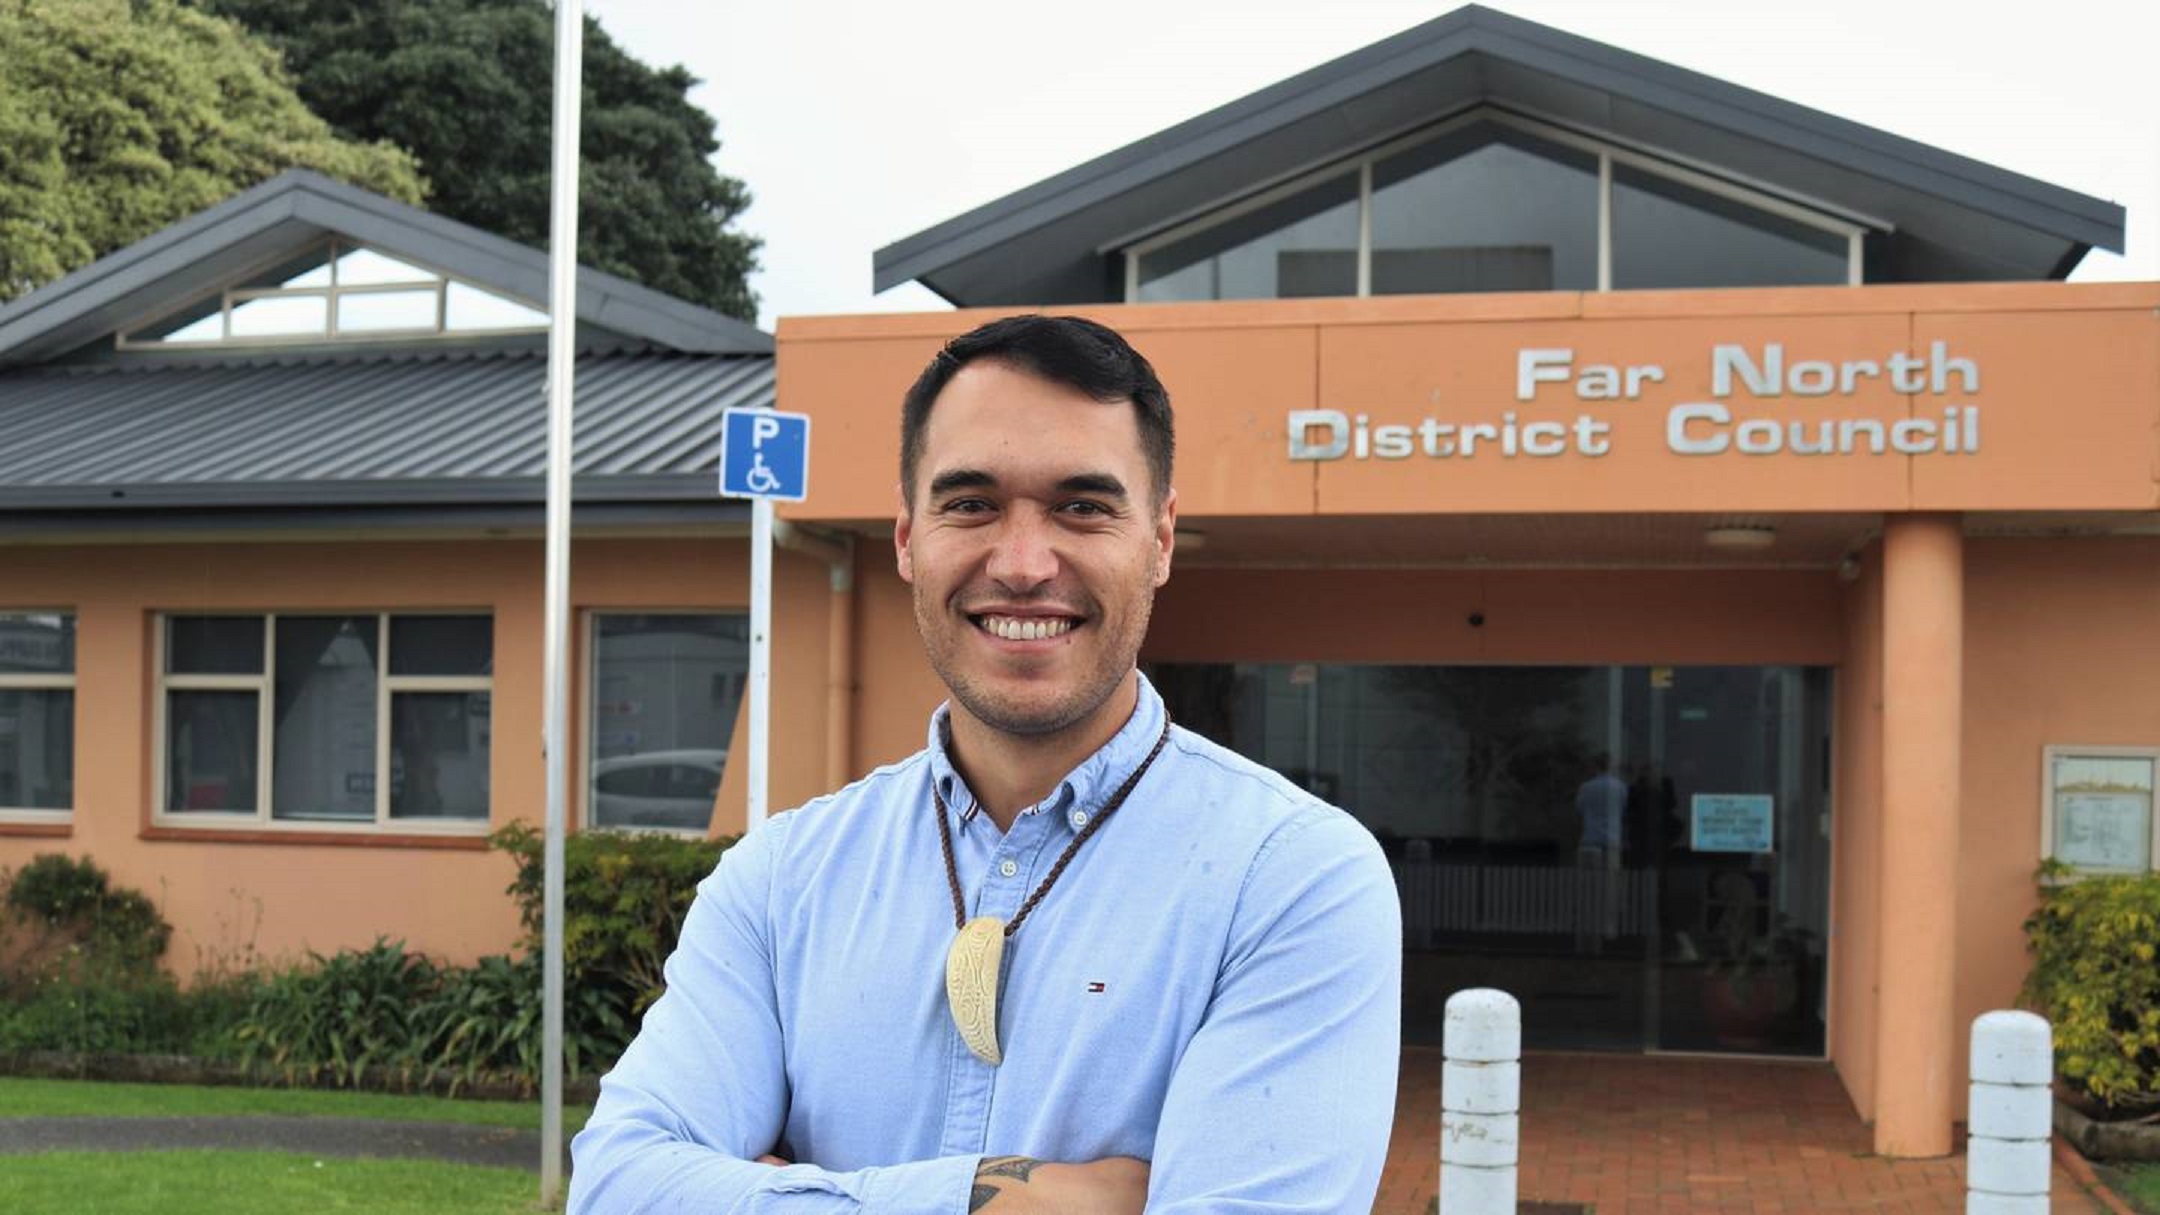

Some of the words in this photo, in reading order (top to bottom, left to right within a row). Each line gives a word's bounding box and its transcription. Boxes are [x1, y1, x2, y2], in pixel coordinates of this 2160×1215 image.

[1516, 348, 1663, 400] Far
[1711, 340, 1980, 396] North
[753, 416, 780, 449] P
[1287, 409, 1610, 461] District
[1667, 402, 1980, 455] Council
